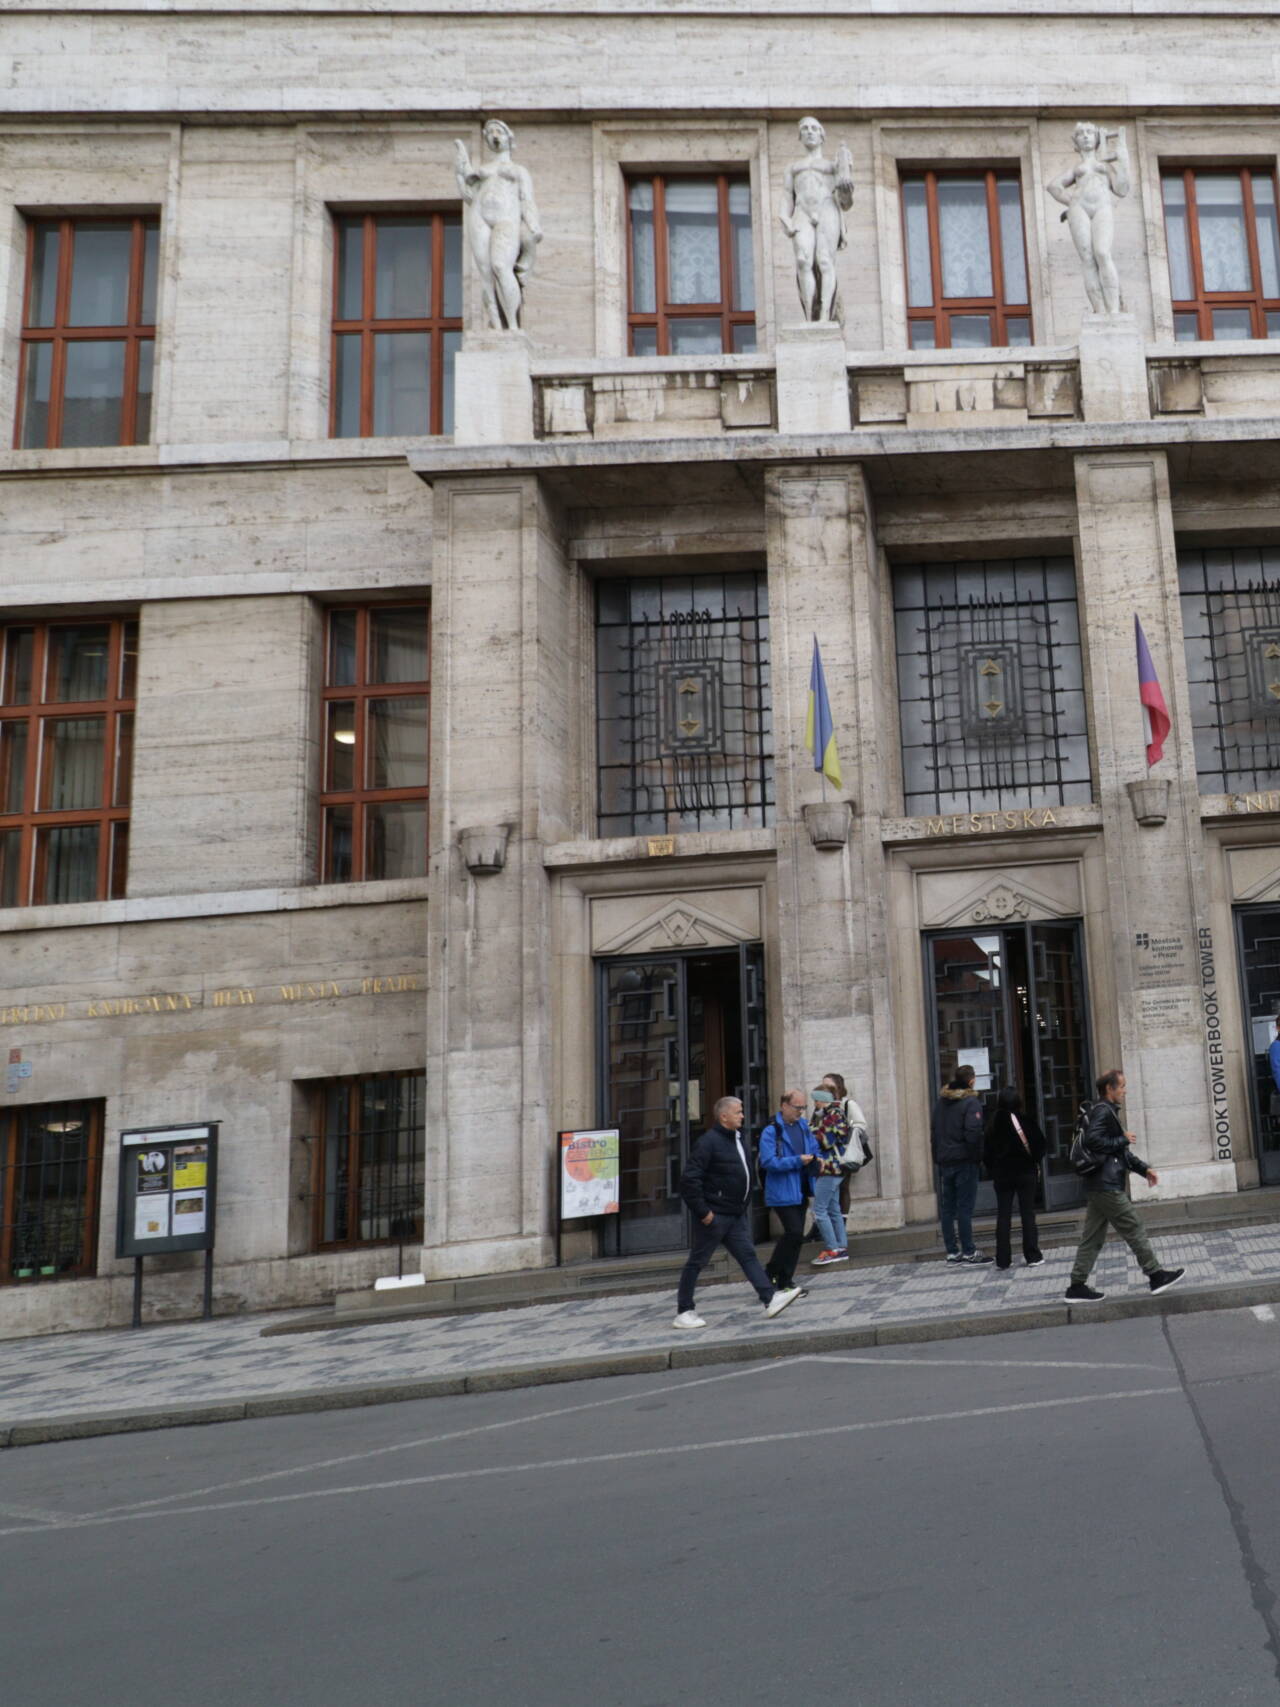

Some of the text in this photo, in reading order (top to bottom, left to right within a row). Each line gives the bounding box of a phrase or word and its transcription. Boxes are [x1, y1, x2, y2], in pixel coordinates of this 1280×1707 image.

[1199, 927, 1232, 1160] BOOK TOWER BOOK TOWER
